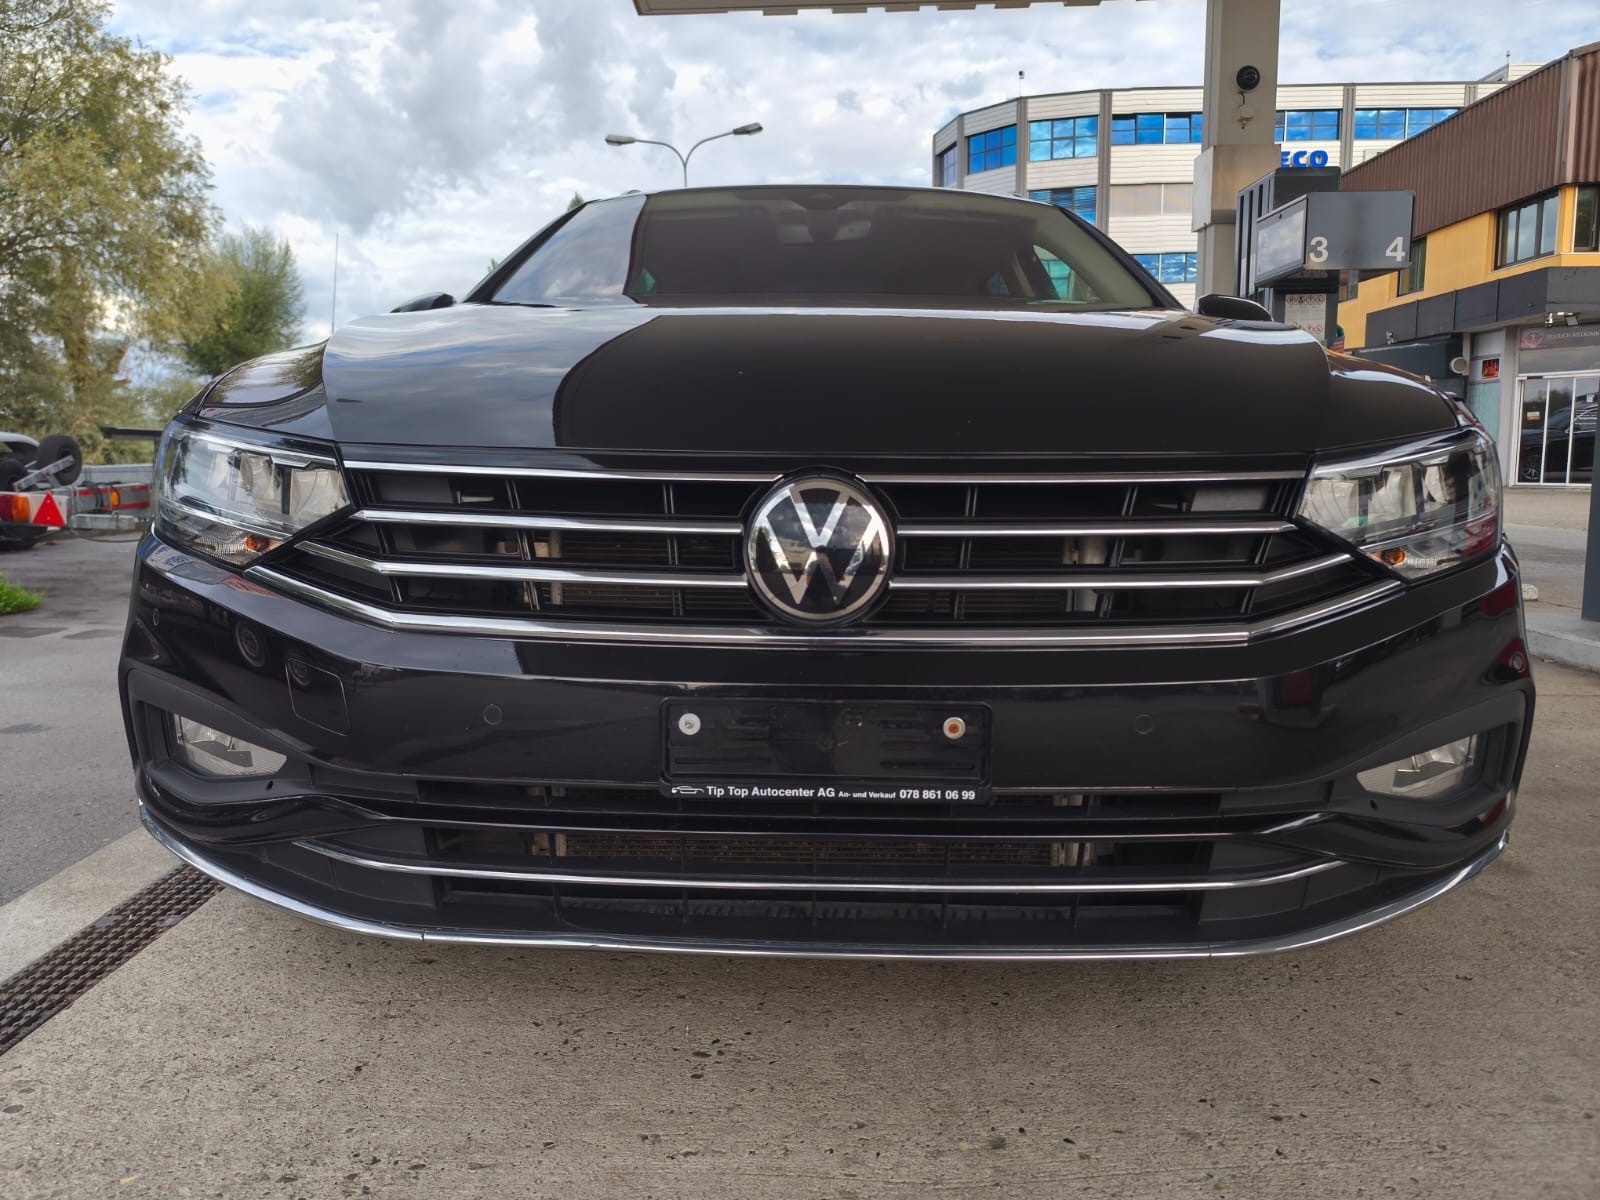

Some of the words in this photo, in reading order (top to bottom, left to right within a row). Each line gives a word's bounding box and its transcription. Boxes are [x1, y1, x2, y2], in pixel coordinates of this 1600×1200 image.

[1309, 236, 1329, 263] 3
[1385, 236, 1406, 262] 4
[706, 785, 725, 798] Tip
[728, 785, 749, 798] Top
[751, 786, 815, 797] Autocenter
[817, 787, 835, 798] AG
[868, 791, 896, 799] Verkauf
[899, 789, 920, 799] 078
[922, 789, 941, 799] 861
[945, 790, 959, 800] 06
[961, 790, 976, 800] 99
